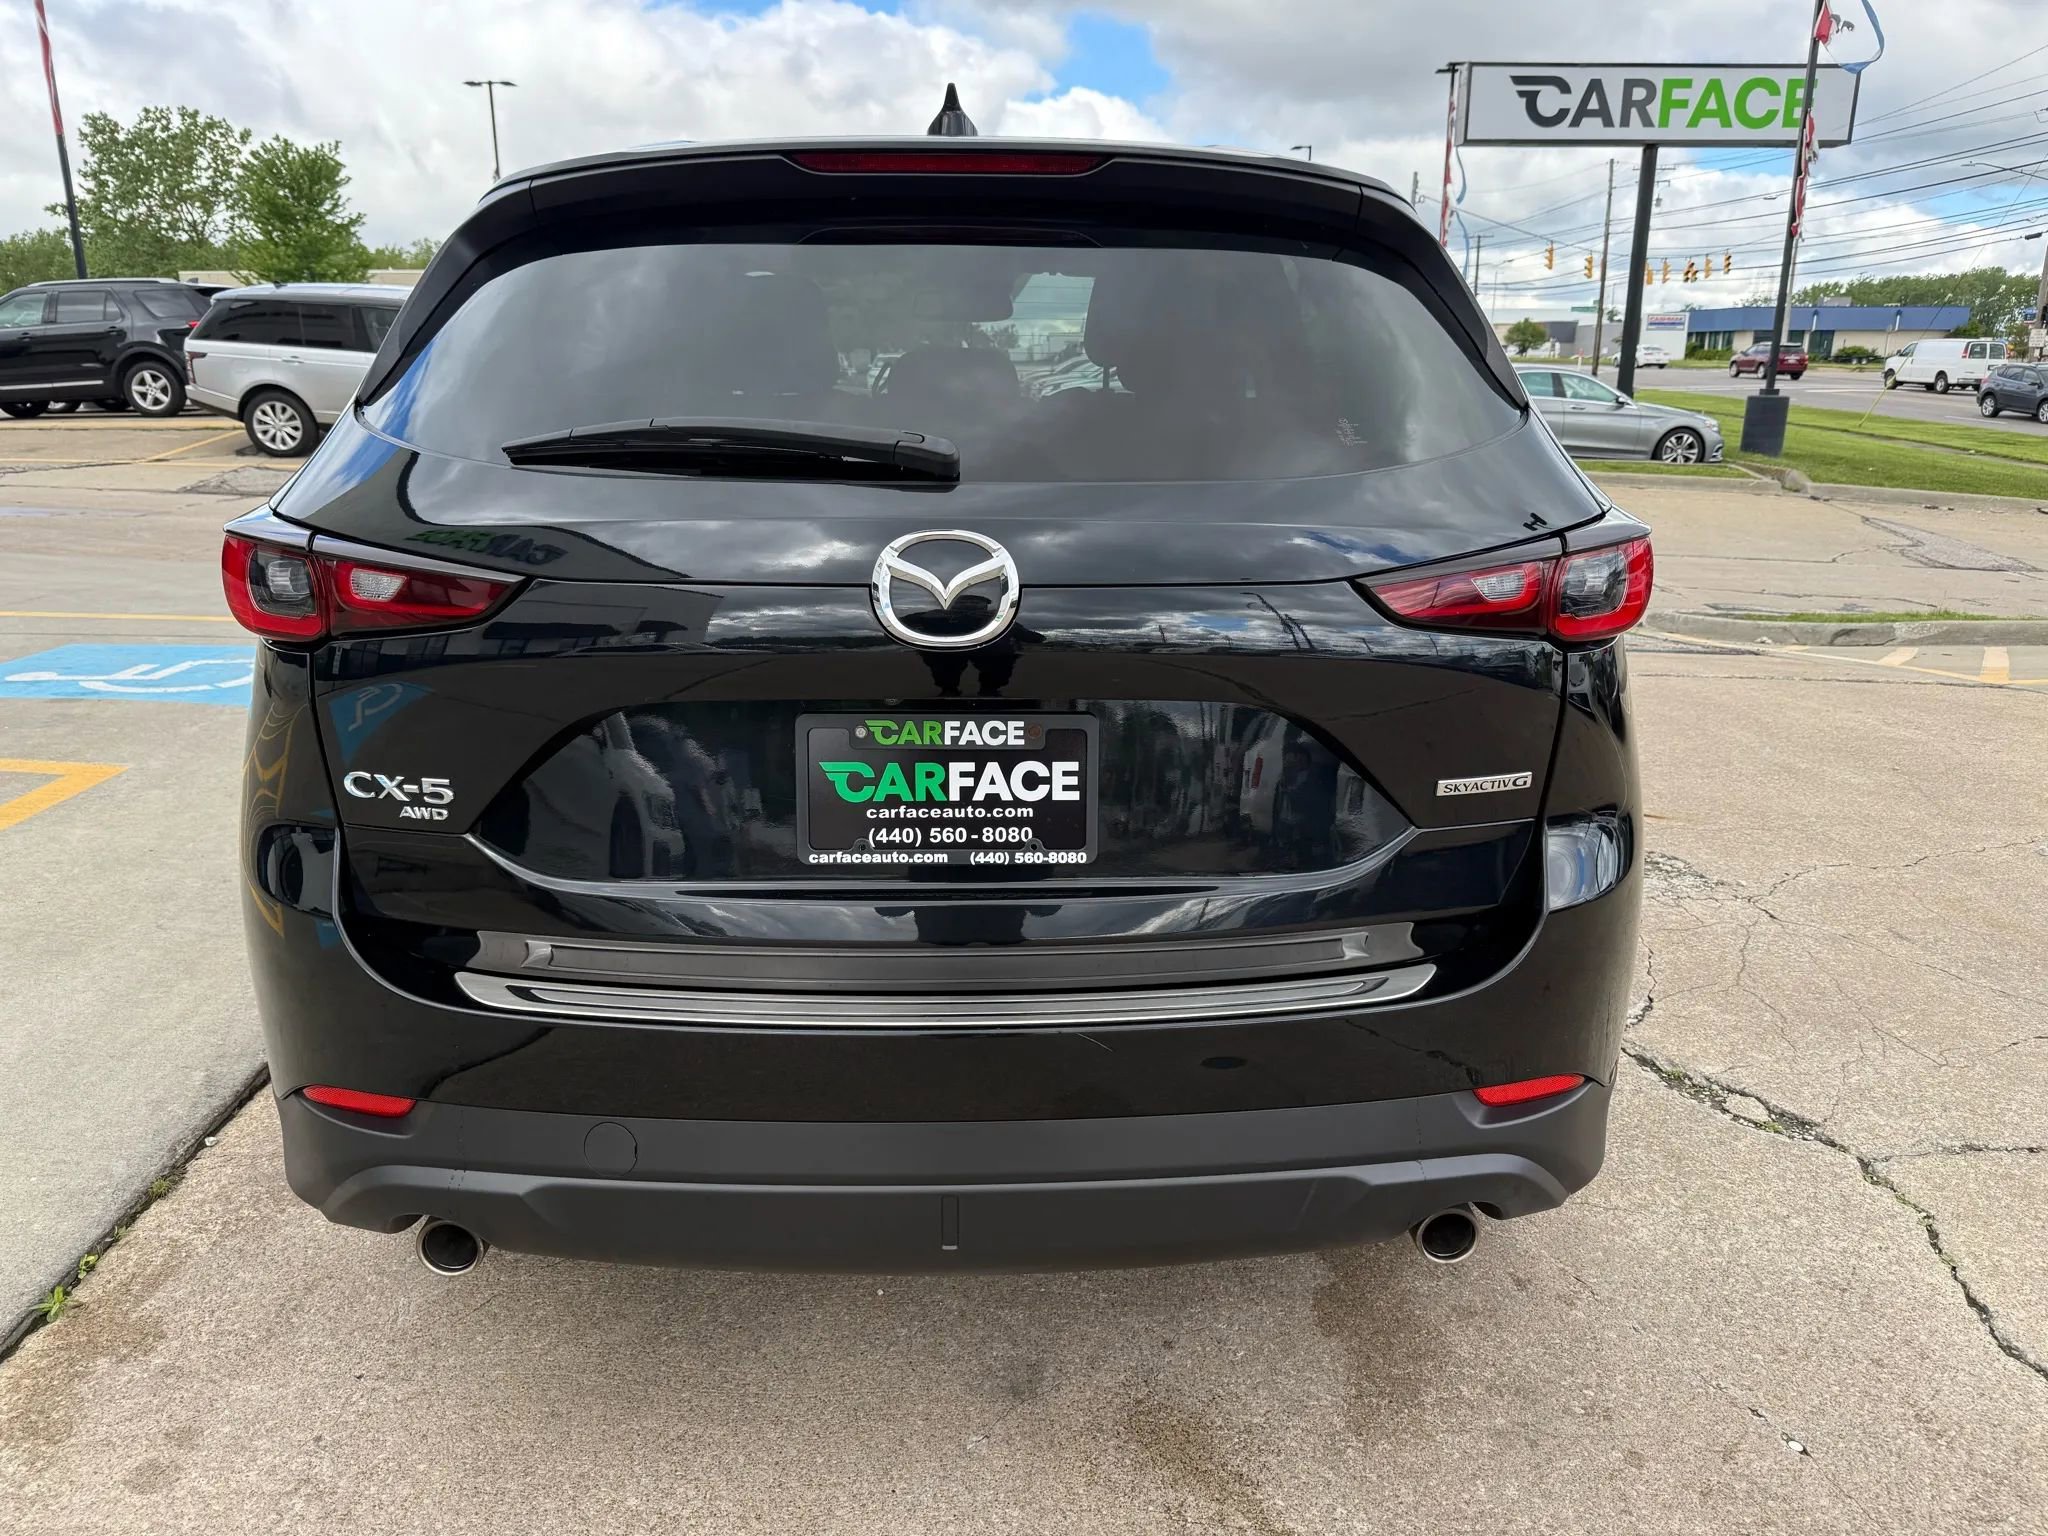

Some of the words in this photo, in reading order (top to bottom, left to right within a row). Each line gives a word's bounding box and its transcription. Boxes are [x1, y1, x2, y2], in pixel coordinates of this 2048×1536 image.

[1509, 75, 1818, 129] CARFACE
[865, 719, 1025, 746] CARFACE
[343, 771, 455, 805] CX-5
[818, 760, 1080, 803] CARFACE
[399, 805, 449, 821] AWD
[866, 805, 1034, 818] carfaceauto.com
[868, 827, 922, 848] (440)
[808, 851, 948, 864] carfaceauto.com
[969, 851, 1010, 866] (440)
[1014, 852, 1088, 864] 560-8080
